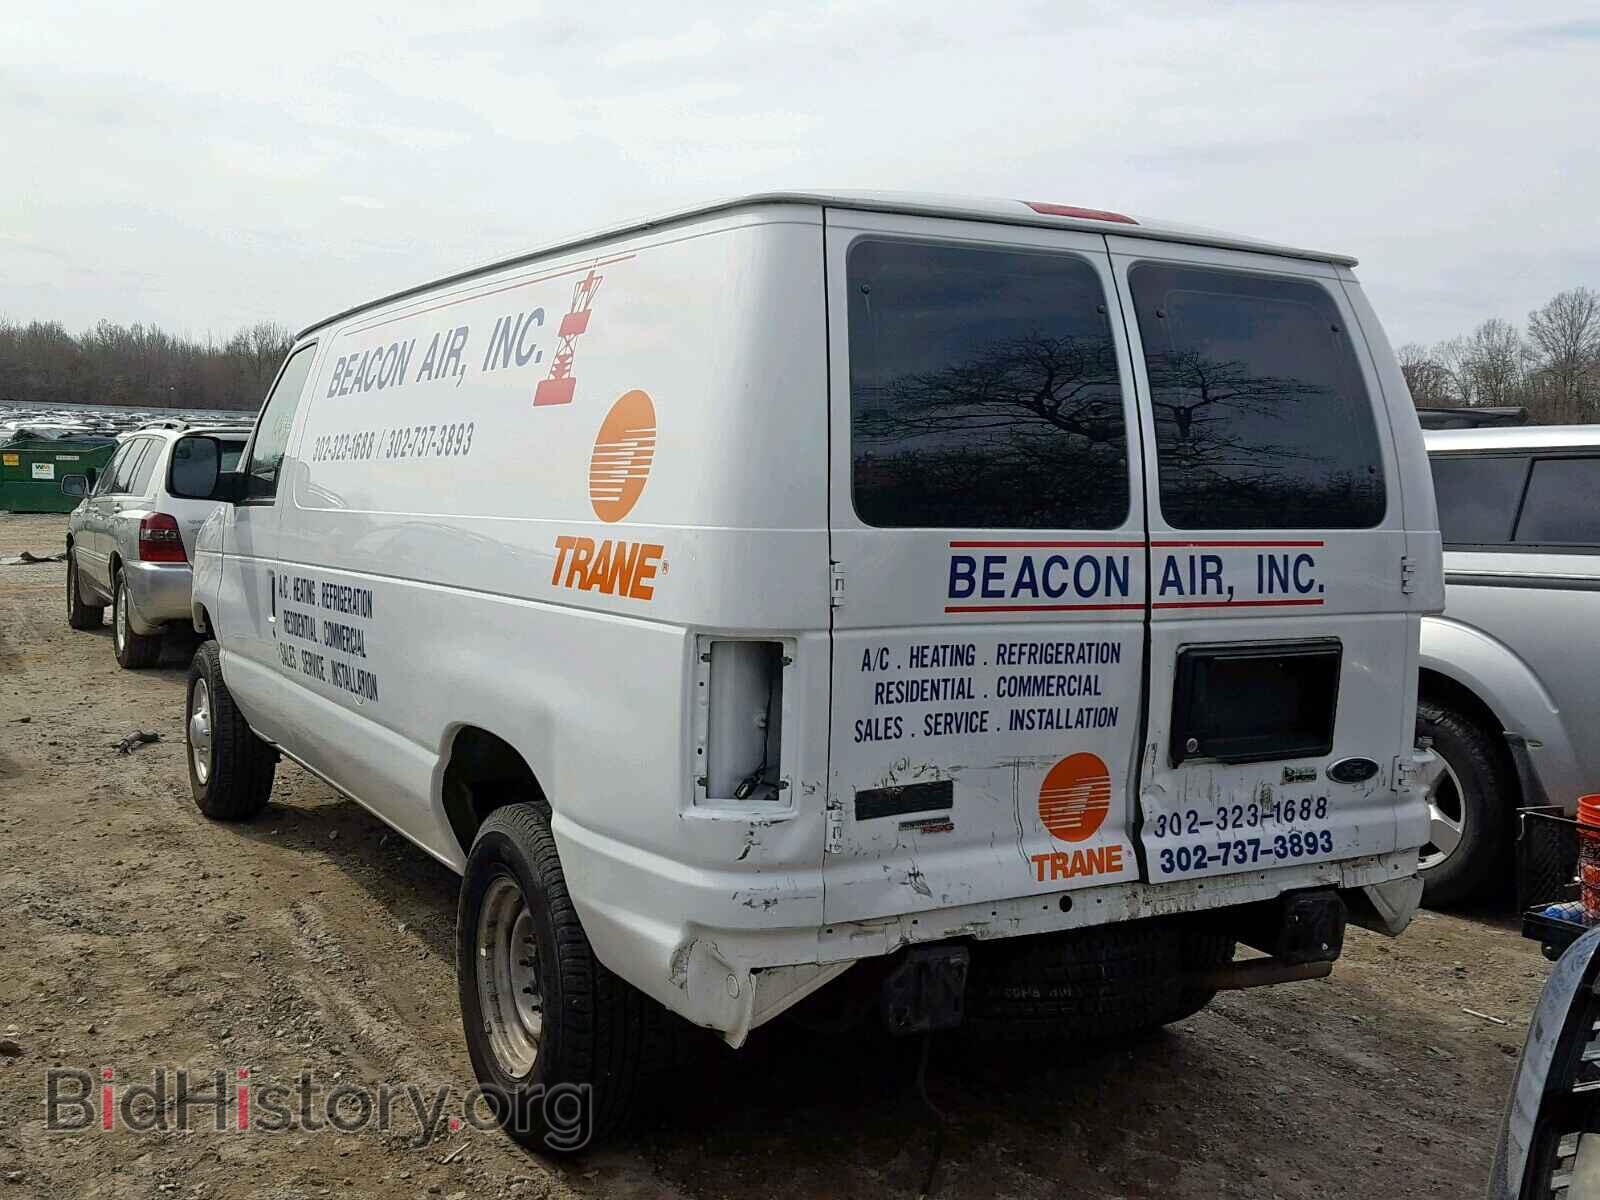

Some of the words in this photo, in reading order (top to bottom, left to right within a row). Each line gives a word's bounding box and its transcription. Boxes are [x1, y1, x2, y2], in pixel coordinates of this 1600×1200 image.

[326, 337, 416, 399] BEACON
[416, 325, 470, 387] AIR,
[482, 307, 545, 372] INC.
[312, 431, 376, 462] 302-323-1688
[386, 422, 474, 459] 302-737-3893
[551, 535, 664, 600] TRANE
[947, 554, 1130, 599] BEACON
[1158, 554, 1234, 602] AIR,
[1256, 553, 1325, 595] INC.
[279, 574, 288, 599] AC
[293, 576, 316, 606] HEATING
[321, 582, 373, 619] REFRIGERATION
[283, 609, 318, 643] RESIDENTIAL
[323, 620, 367, 658] COMMERCIAL
[279, 642, 297, 669] SALES
[301, 649, 326, 682] SERVICE
[331, 659, 379, 703] INSTALLATION
[861, 647, 889, 672] A/C
[909, 643, 976, 669] HEATING
[996, 642, 1121, 667] REFRIGERATION
[874, 677, 976, 705] RESIDENTIAL
[996, 674, 1102, 699] COMMERCIAL
[854, 715, 904, 743] SALES
[923, 710, 990, 737] SERVICE
[1008, 706, 1119, 731] INSTALLATION
[1154, 796, 1329, 838] 302-323-1688
[1031, 845, 1124, 882] TRANE
[1160, 830, 1333, 874] 302-737-3893
